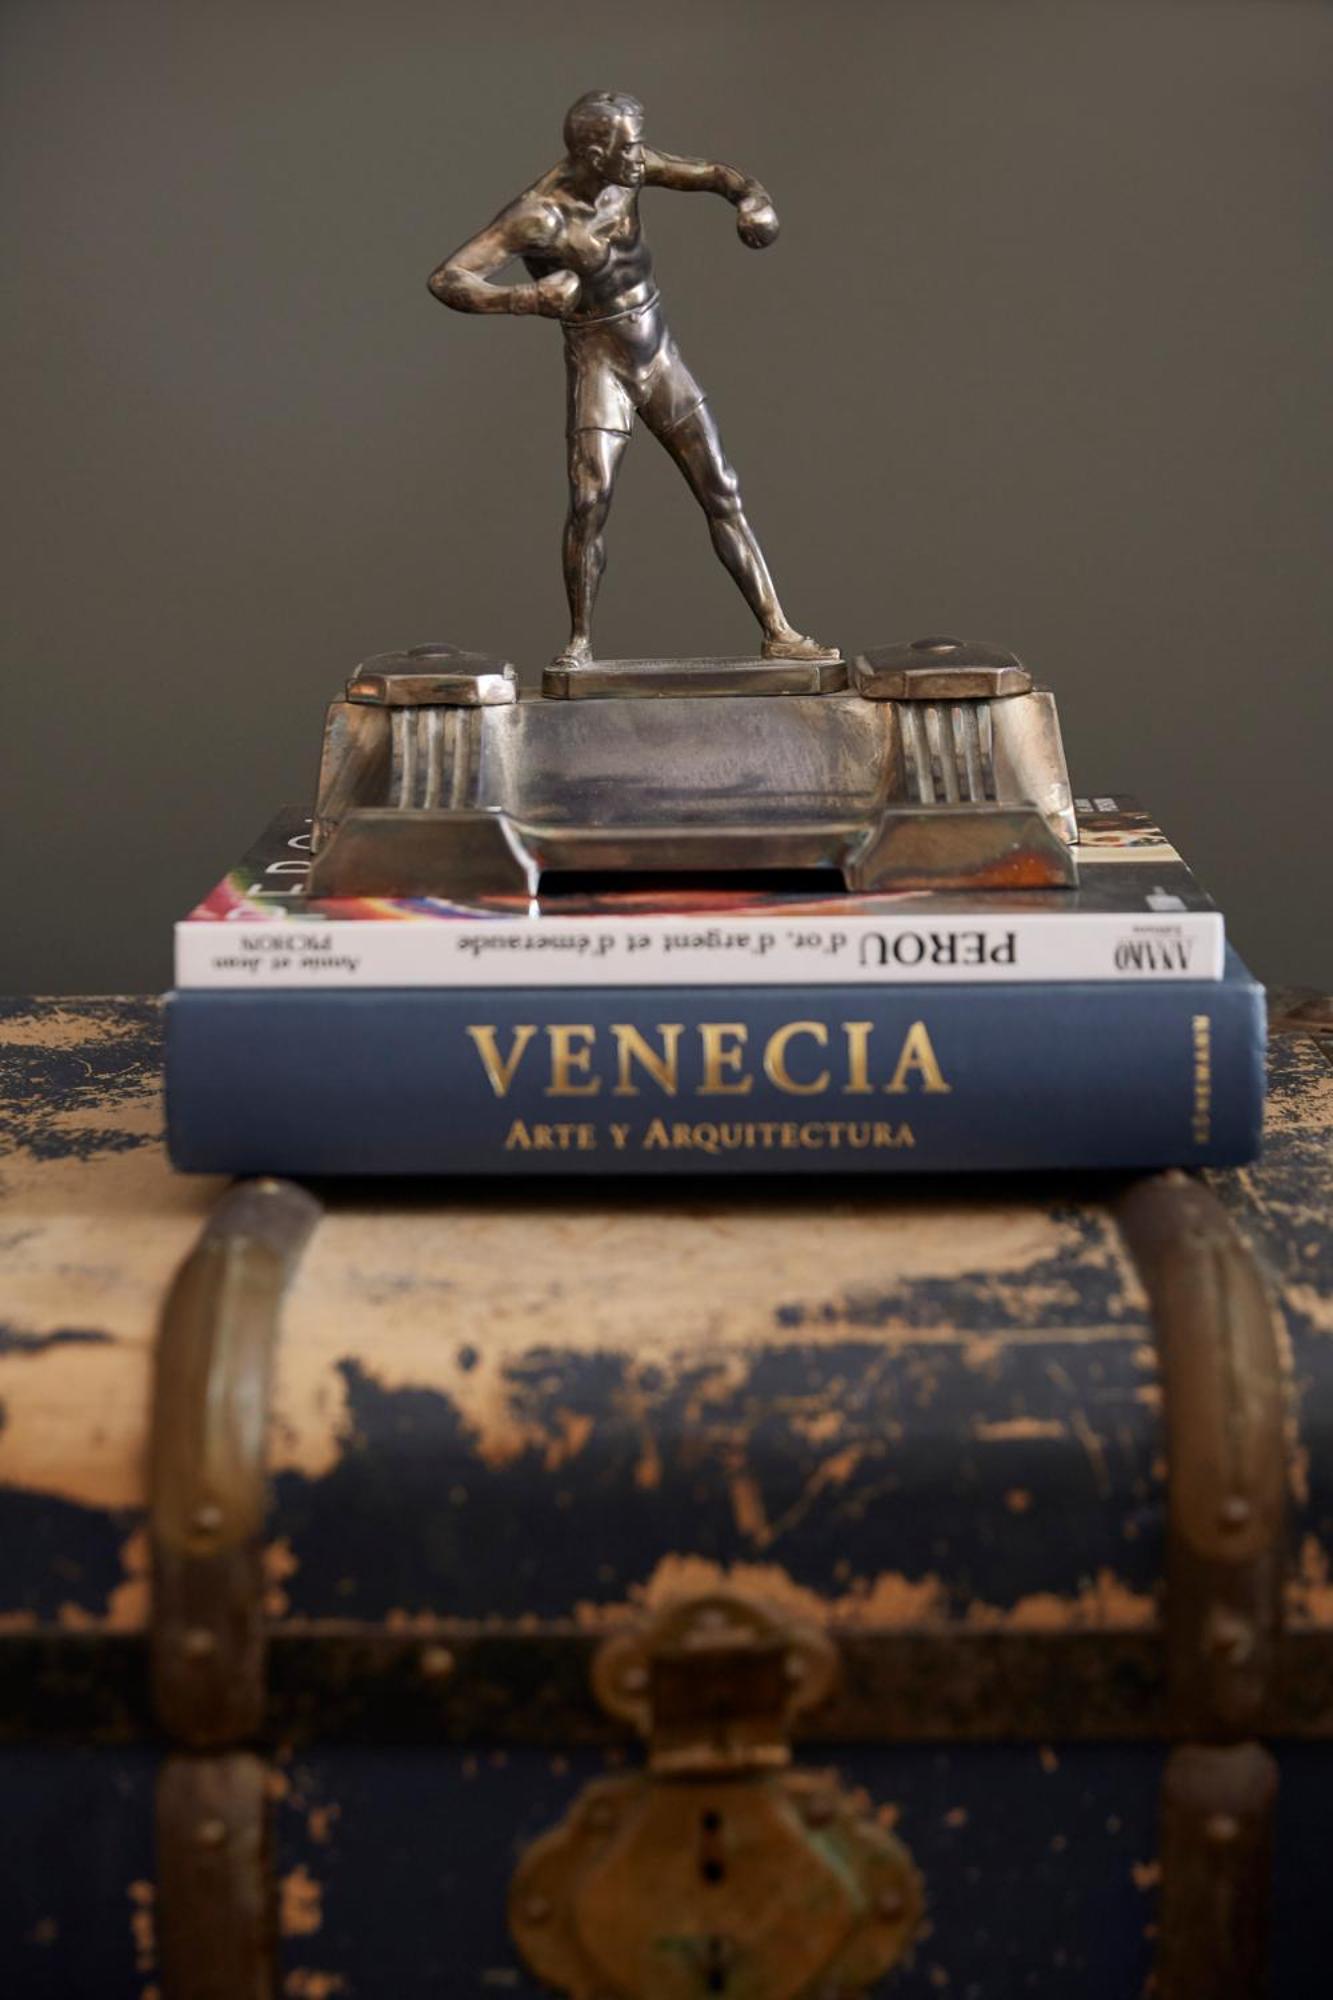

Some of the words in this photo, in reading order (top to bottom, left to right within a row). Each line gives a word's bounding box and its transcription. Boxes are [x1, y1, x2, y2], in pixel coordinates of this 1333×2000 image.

[456, 931, 615, 957] d'émeraude
[626, 933, 651, 951] et
[664, 930, 775, 955] d'argent
[787, 932, 847, 955] d'or,
[858, 931, 1017, 967] PEROU
[212, 956, 262, 973] Jean
[270, 956, 291, 970] et
[299, 956, 360, 973] Annie
[467, 1020, 950, 1096] VENECIA
